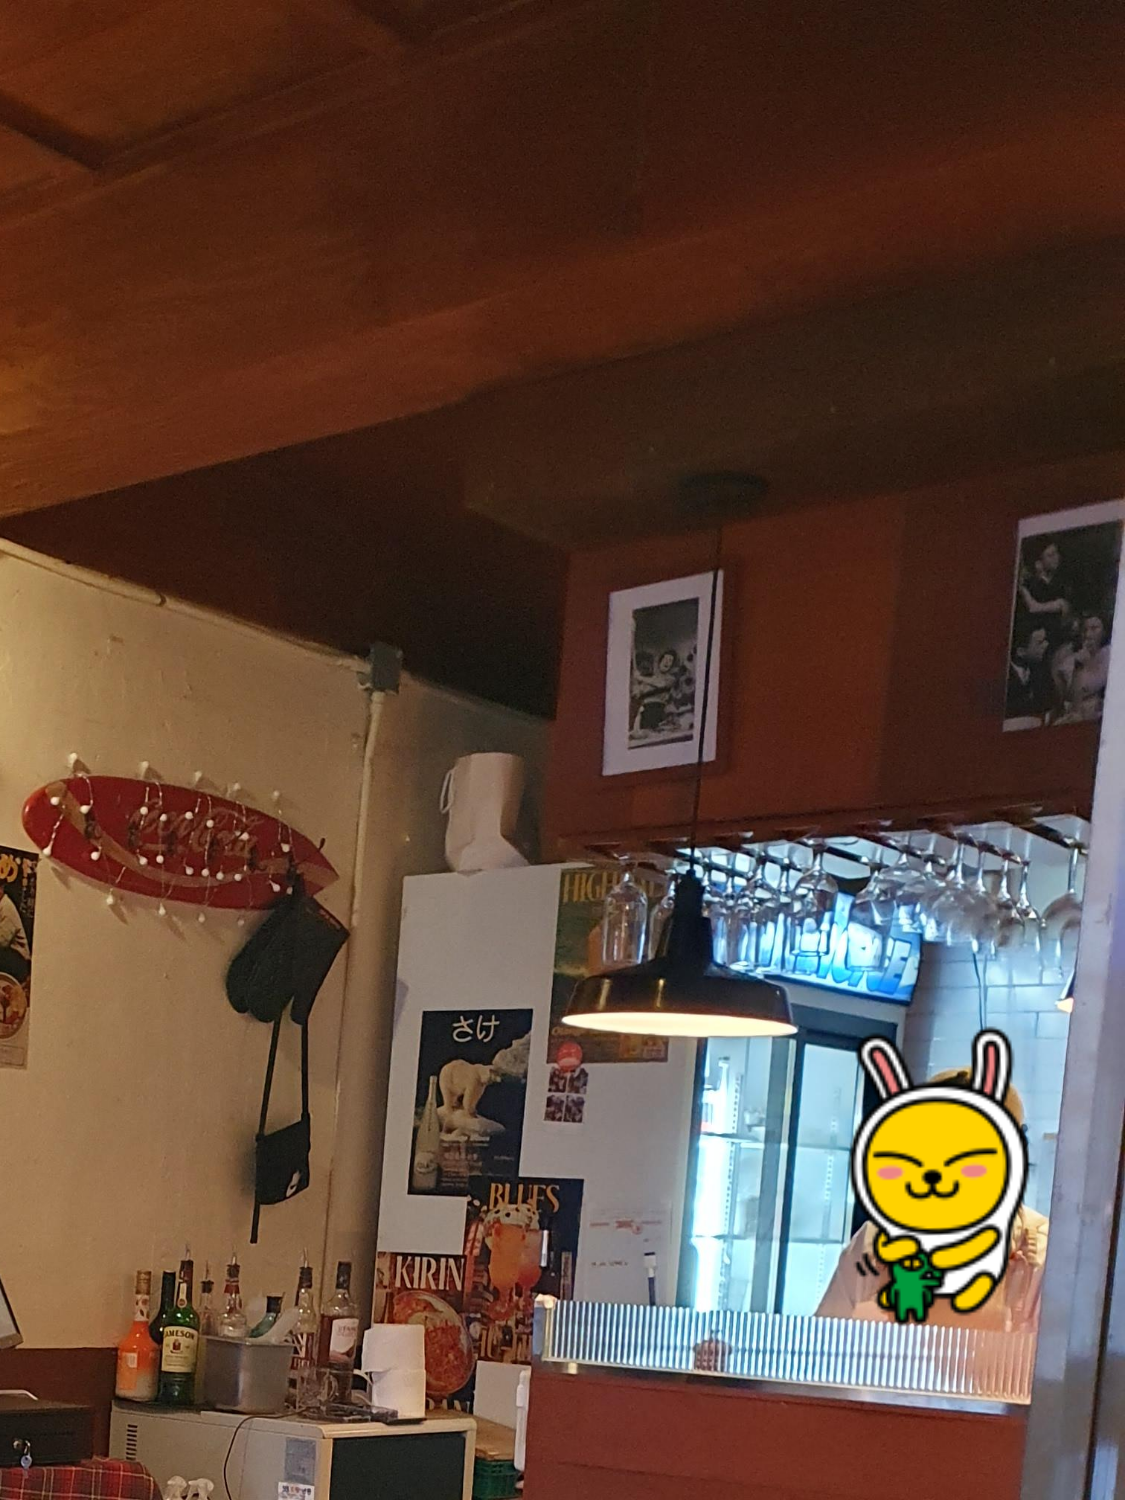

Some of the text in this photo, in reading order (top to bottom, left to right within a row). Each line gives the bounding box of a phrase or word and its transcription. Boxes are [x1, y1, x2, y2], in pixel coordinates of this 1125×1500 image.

[452, 1014, 500, 1042] さけ
[488, 1182, 560, 1214] BLUES
[395, 1255, 465, 1292] KIRIN
